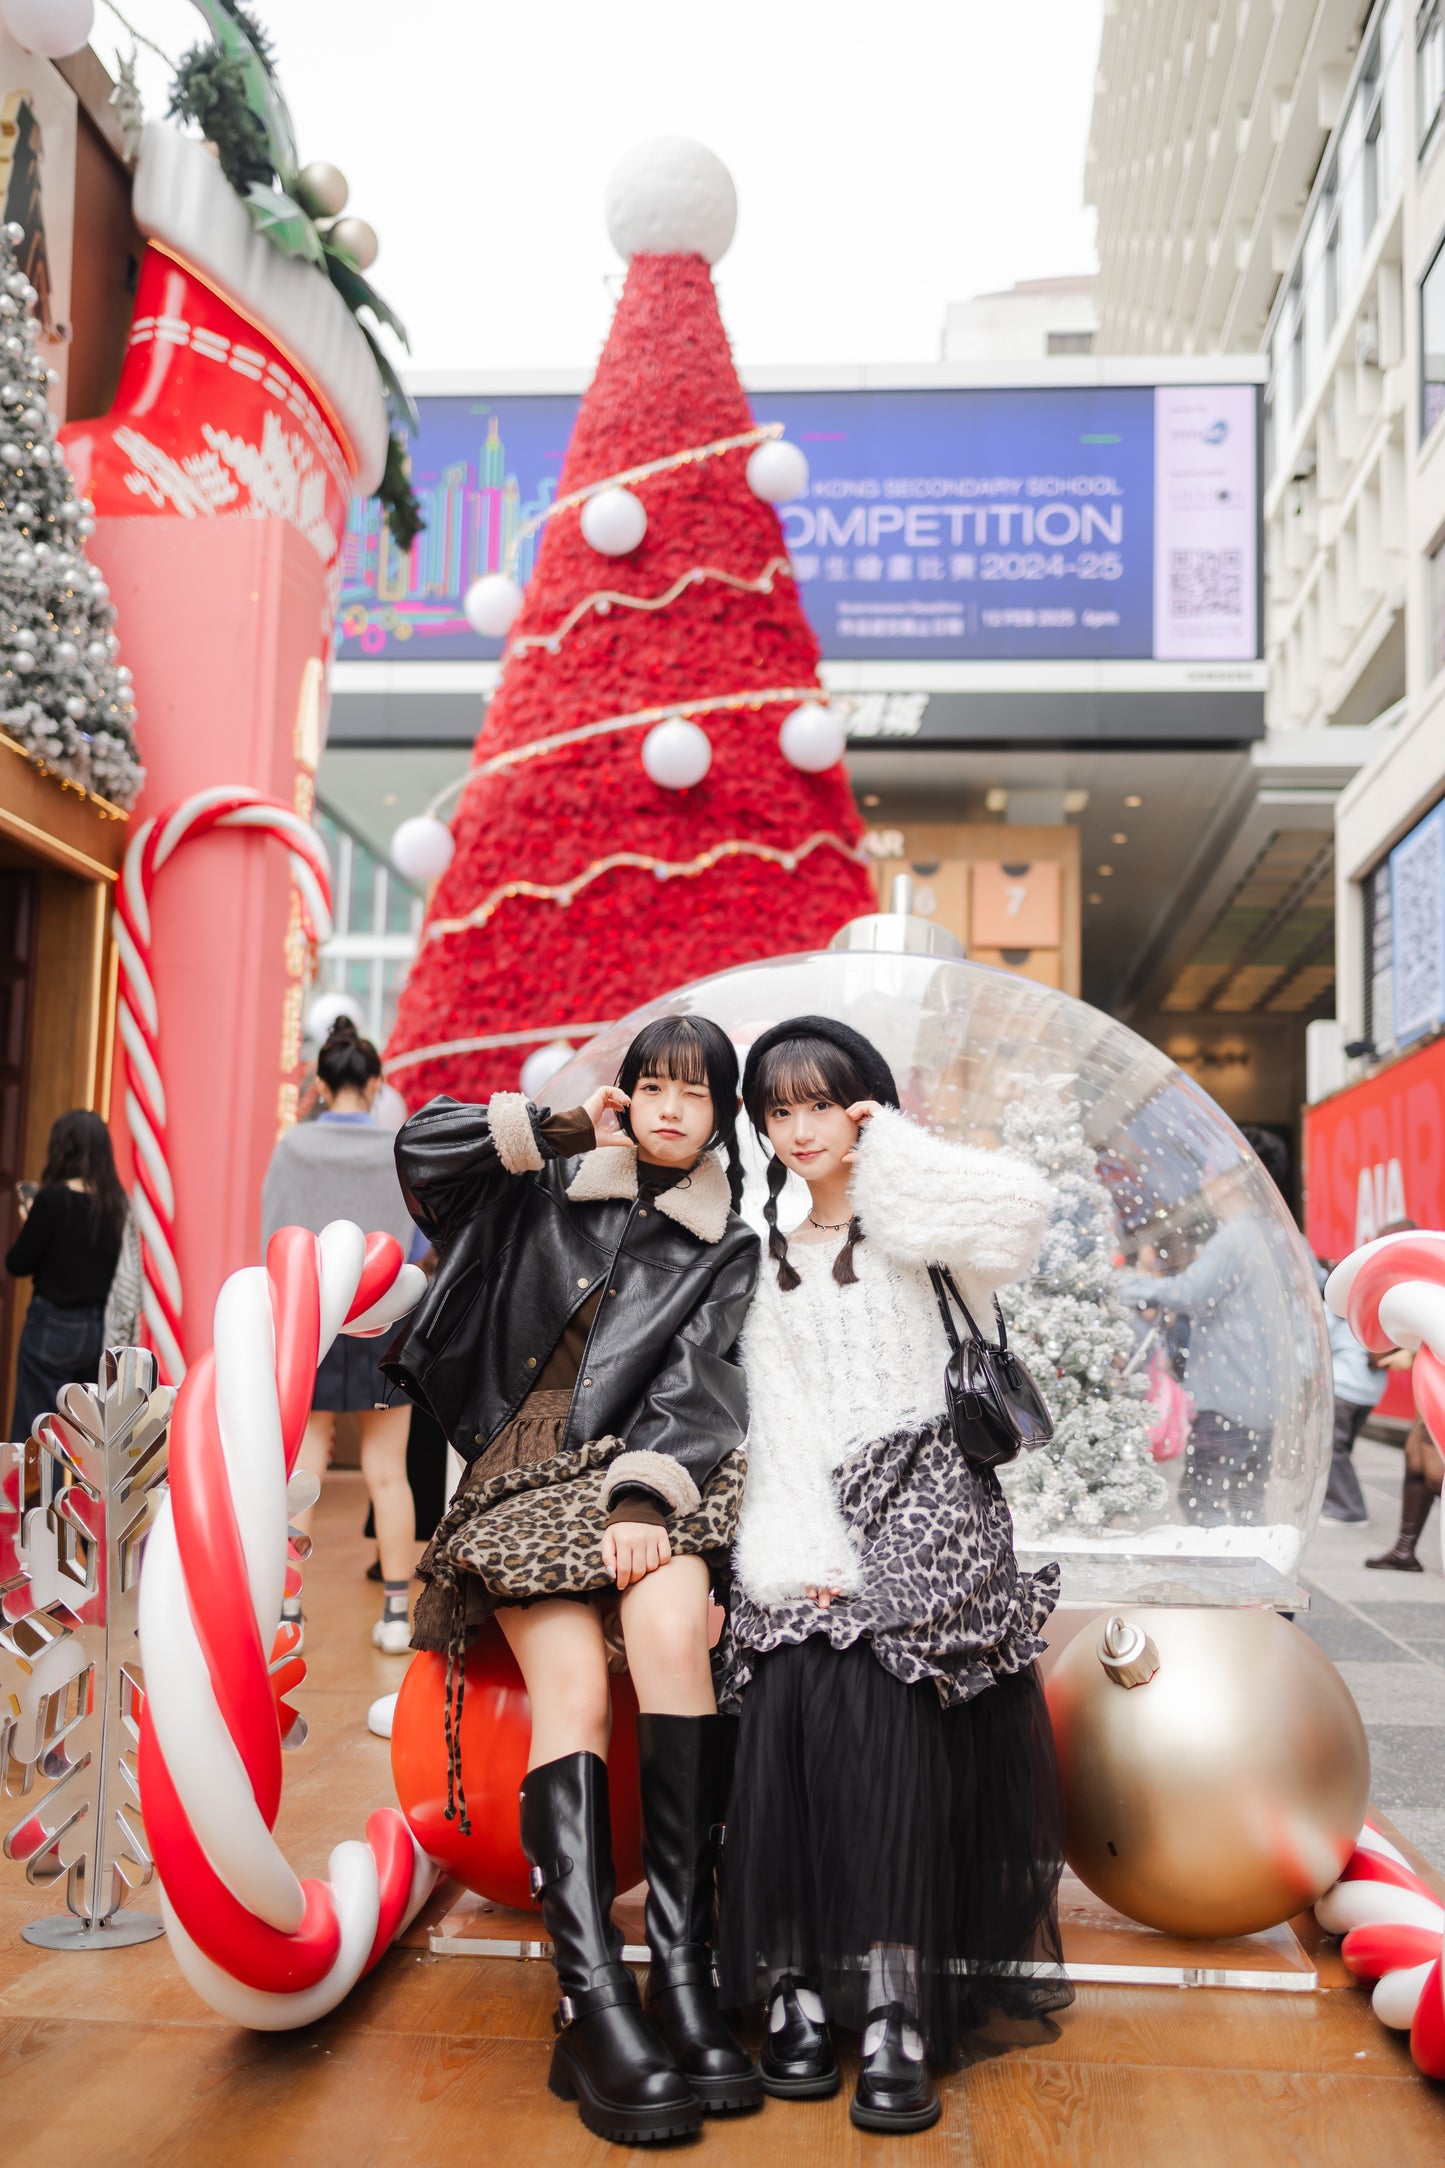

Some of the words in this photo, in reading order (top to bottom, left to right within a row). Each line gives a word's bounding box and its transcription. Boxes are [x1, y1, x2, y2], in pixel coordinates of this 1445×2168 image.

[812, 479, 881, 499] KONG
[883, 477, 1024, 499] SECONDARY
[1025, 475, 1125, 498] SCHOOL
[780, 502, 1124, 549] OMPETITION
[979, 552, 1125, 581] 2024-25
[1004, 885, 1027, 919] 7
[1354, 1157, 1408, 1252] AIA
